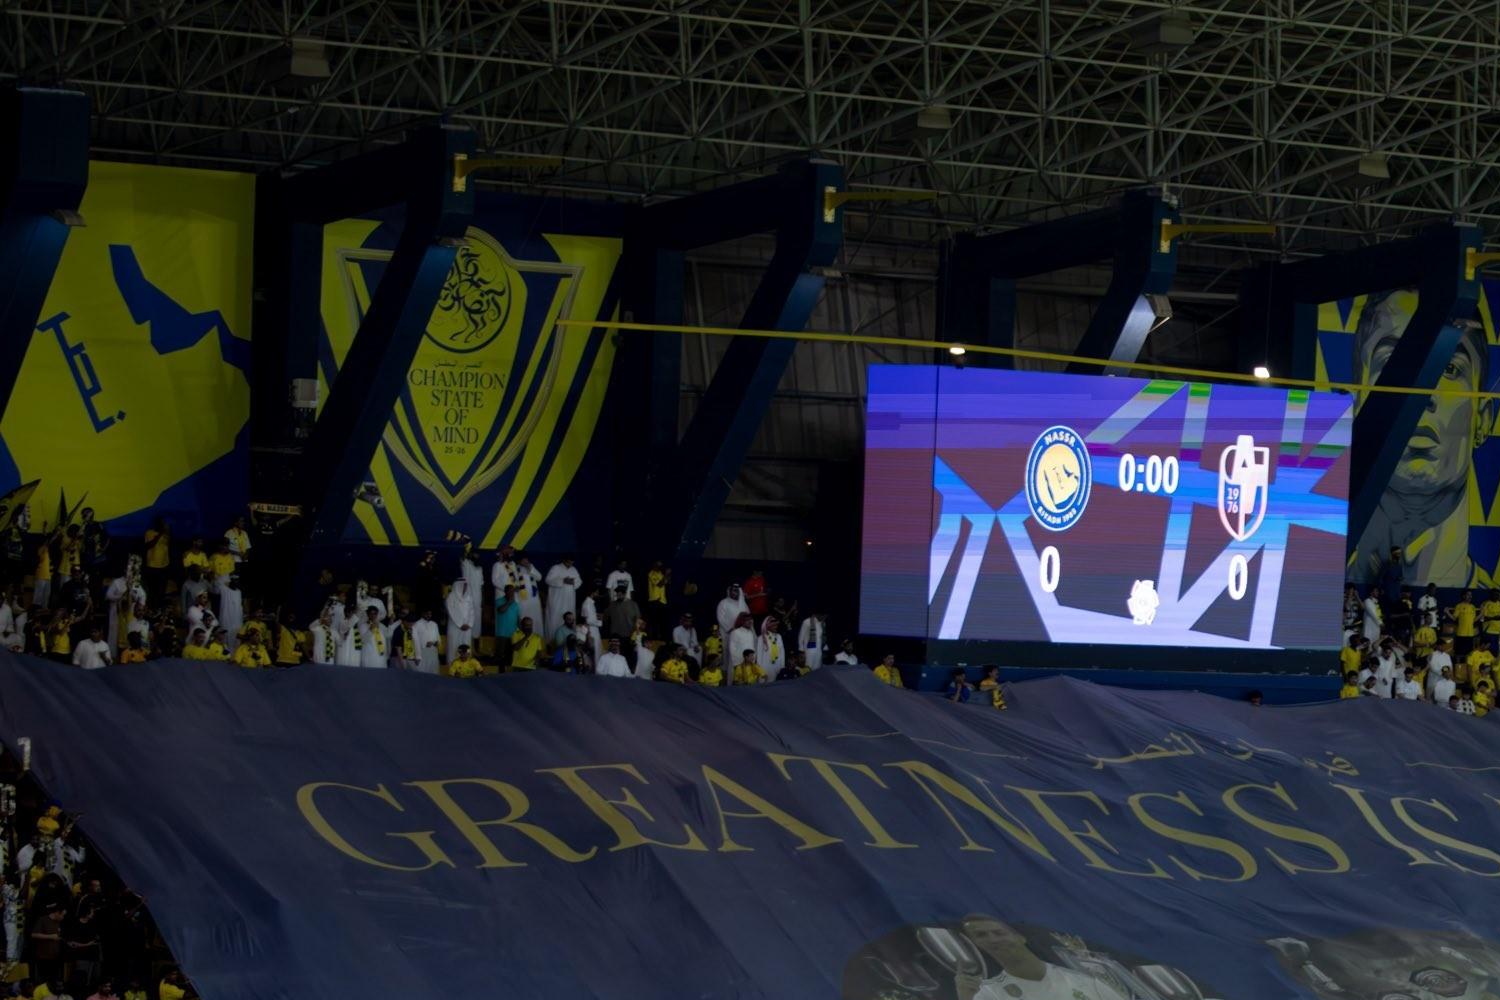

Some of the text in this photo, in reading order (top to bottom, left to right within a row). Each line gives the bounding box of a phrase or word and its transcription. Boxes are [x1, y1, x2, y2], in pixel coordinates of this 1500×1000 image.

[410, 368, 507, 390] CHAMPION
[431, 389, 484, 408] STATE
[444, 407, 470, 426] OF
[433, 426, 479, 445] MIND
[1044, 431, 1076, 447] NASSR
[1119, 453, 1179, 494] 0:00
[1227, 487, 1239, 500] 19
[1227, 501, 1239, 514] 76
[1039, 546, 1061, 593] 0
[1228, 554, 1248, 600] 0
[296, 752, 1351, 882] GREATNESS
